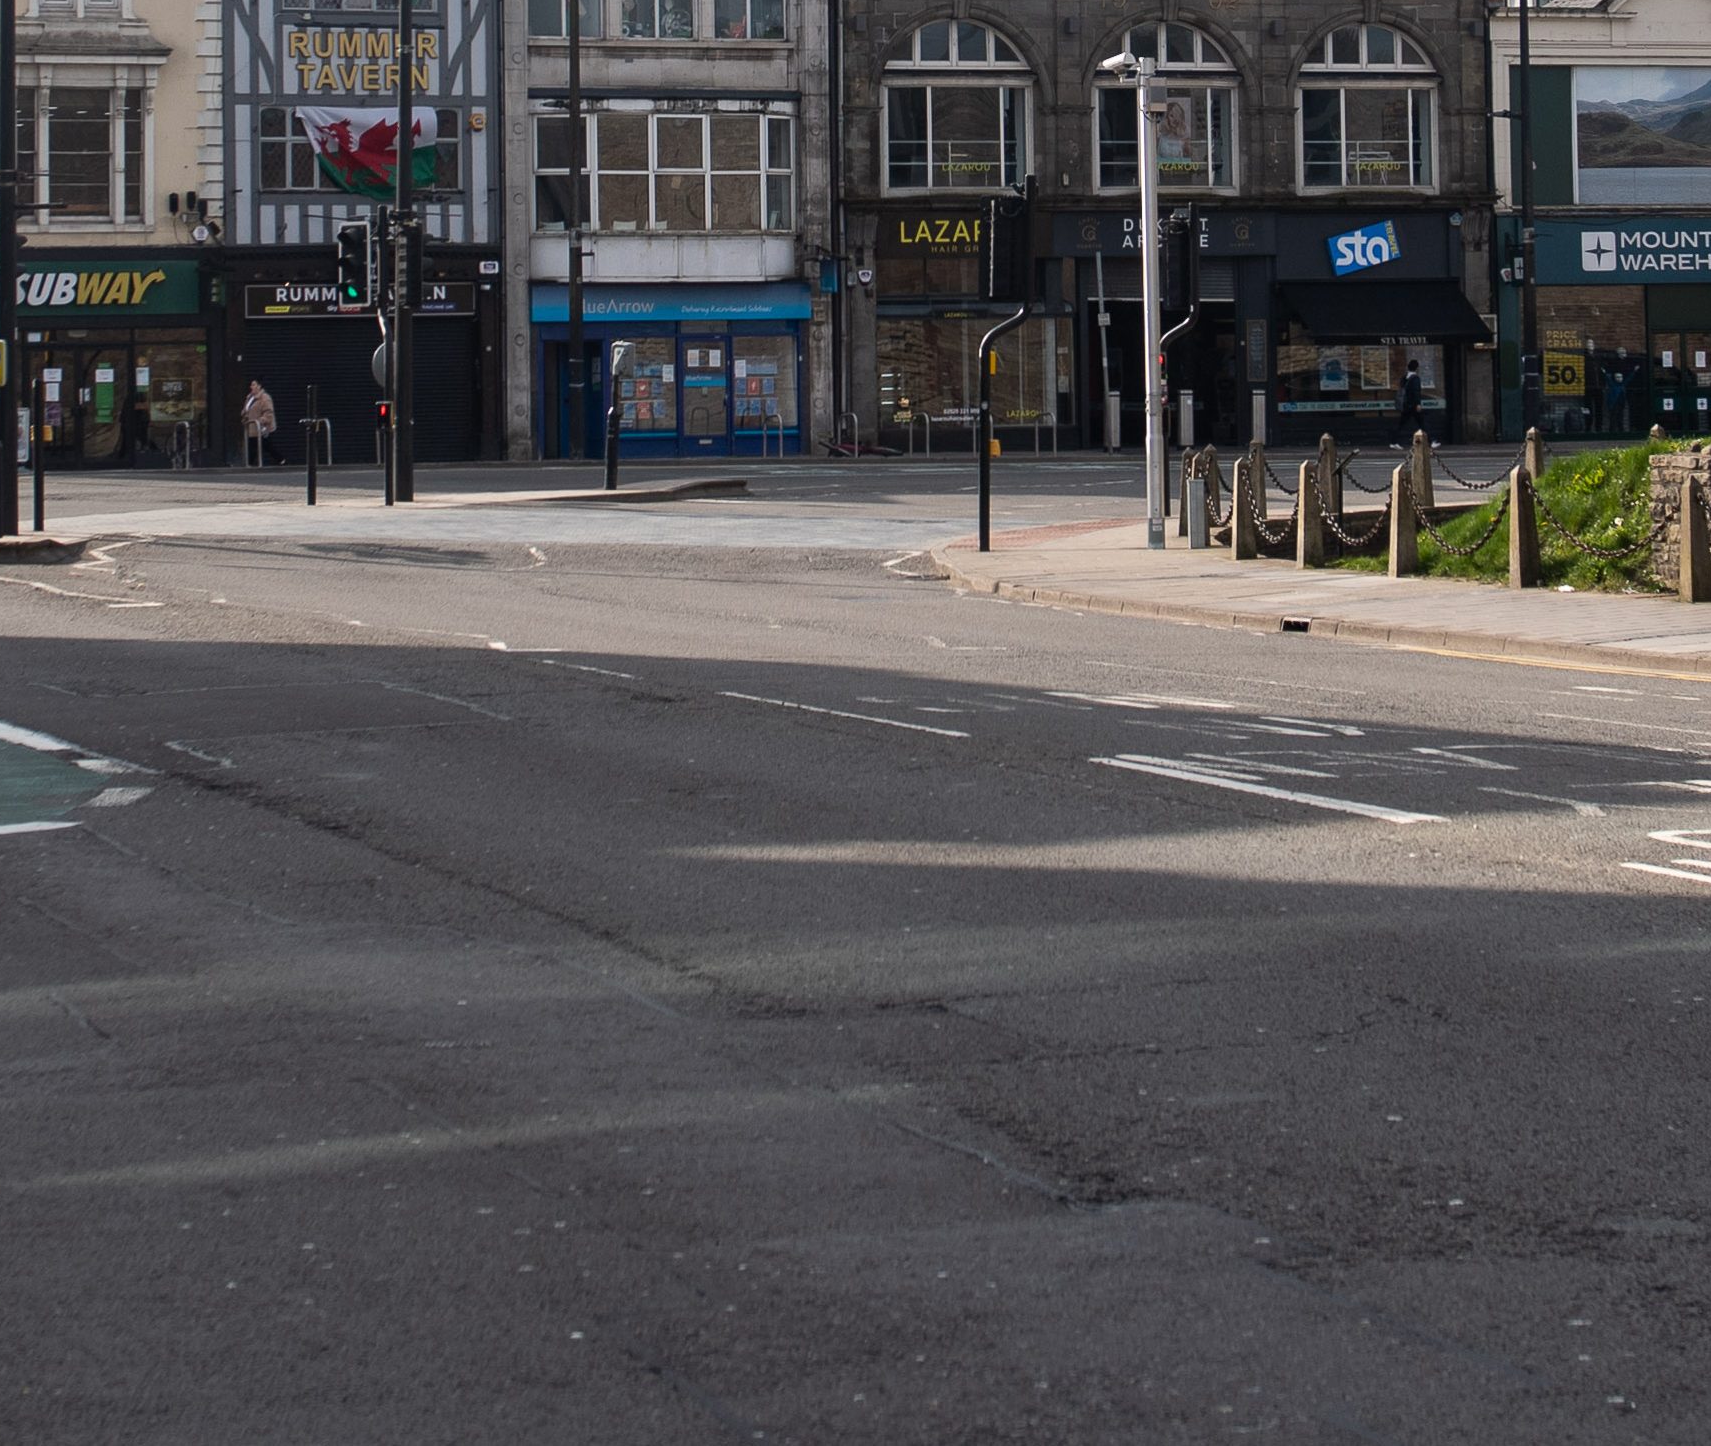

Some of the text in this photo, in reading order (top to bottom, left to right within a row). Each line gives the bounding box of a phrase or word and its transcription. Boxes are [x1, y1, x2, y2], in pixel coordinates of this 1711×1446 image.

[296, 63, 429, 90] TAVERN
[1158, 162, 1200, 172] AZAROU
[931, 245, 958, 253] HAIR
[1336, 230, 1389, 267] sta
[276, 287, 337, 302] RUMM
[1546, 329, 1578, 339] PRICE
[1380, 336, 1428, 345] STA TRAVEL
[1546, 339, 1582, 348] CRASH
[1547, 365, 1576, 385] 50
